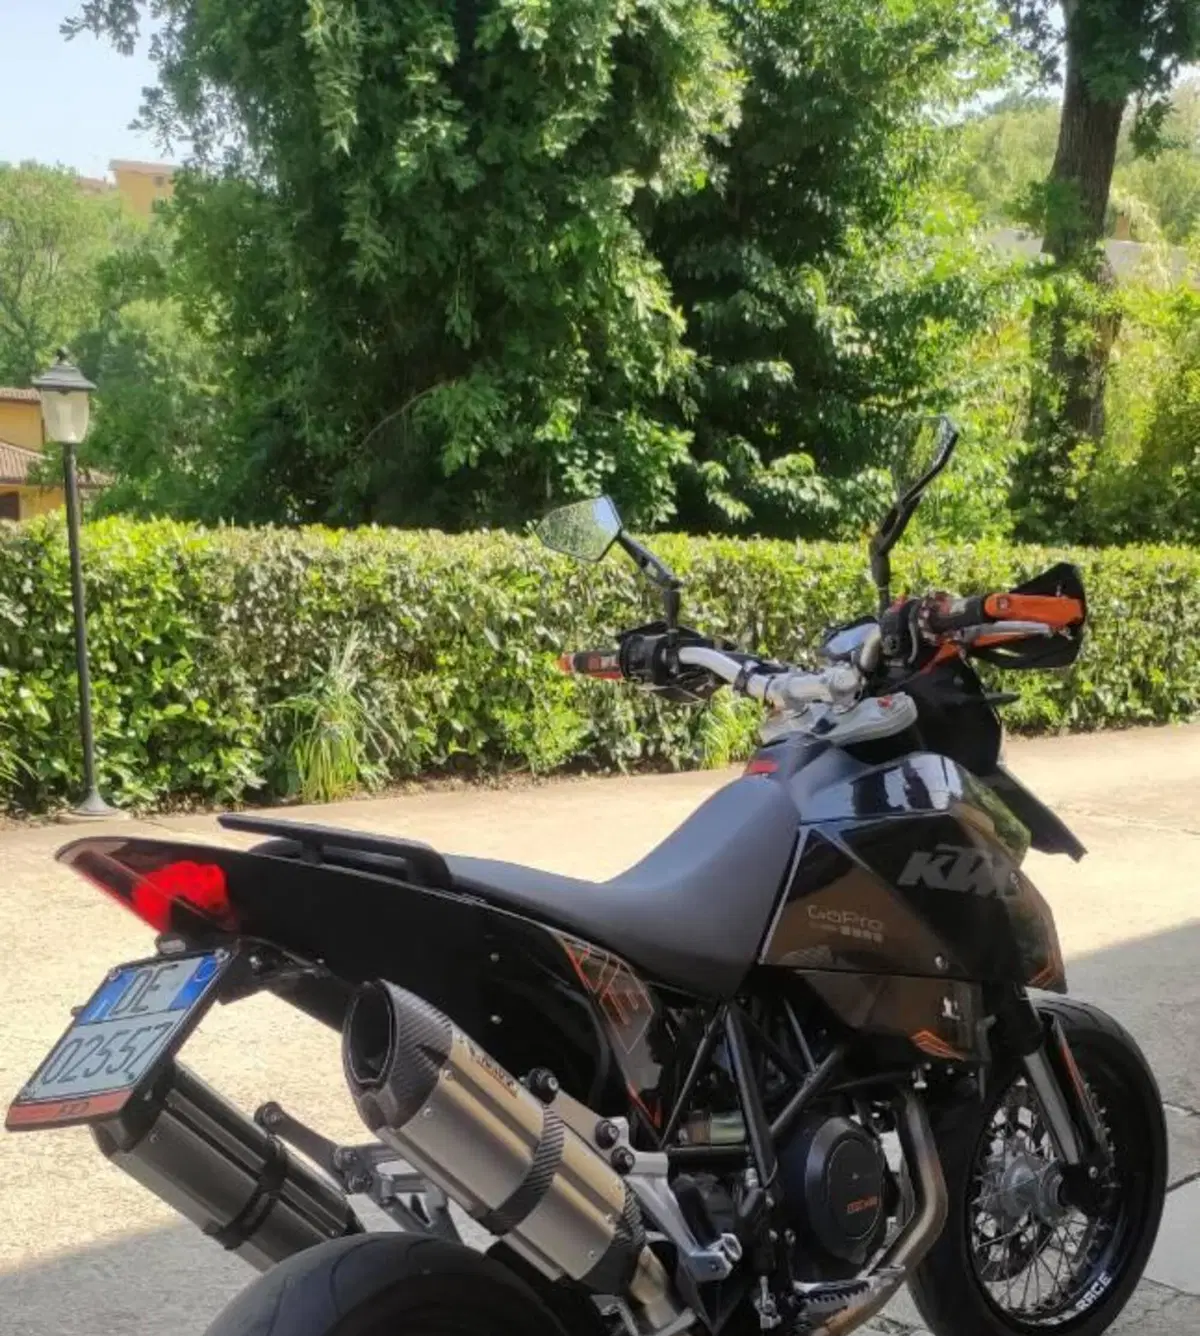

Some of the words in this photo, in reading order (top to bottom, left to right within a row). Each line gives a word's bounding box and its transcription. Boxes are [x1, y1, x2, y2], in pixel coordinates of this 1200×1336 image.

[896, 843, 1010, 899] KTM
[807, 904, 884, 933] GoPro
[110, 963, 179, 1016] DE
[42, 1021, 174, 1085] 02557
[1075, 1271, 1113, 1312] RACE
